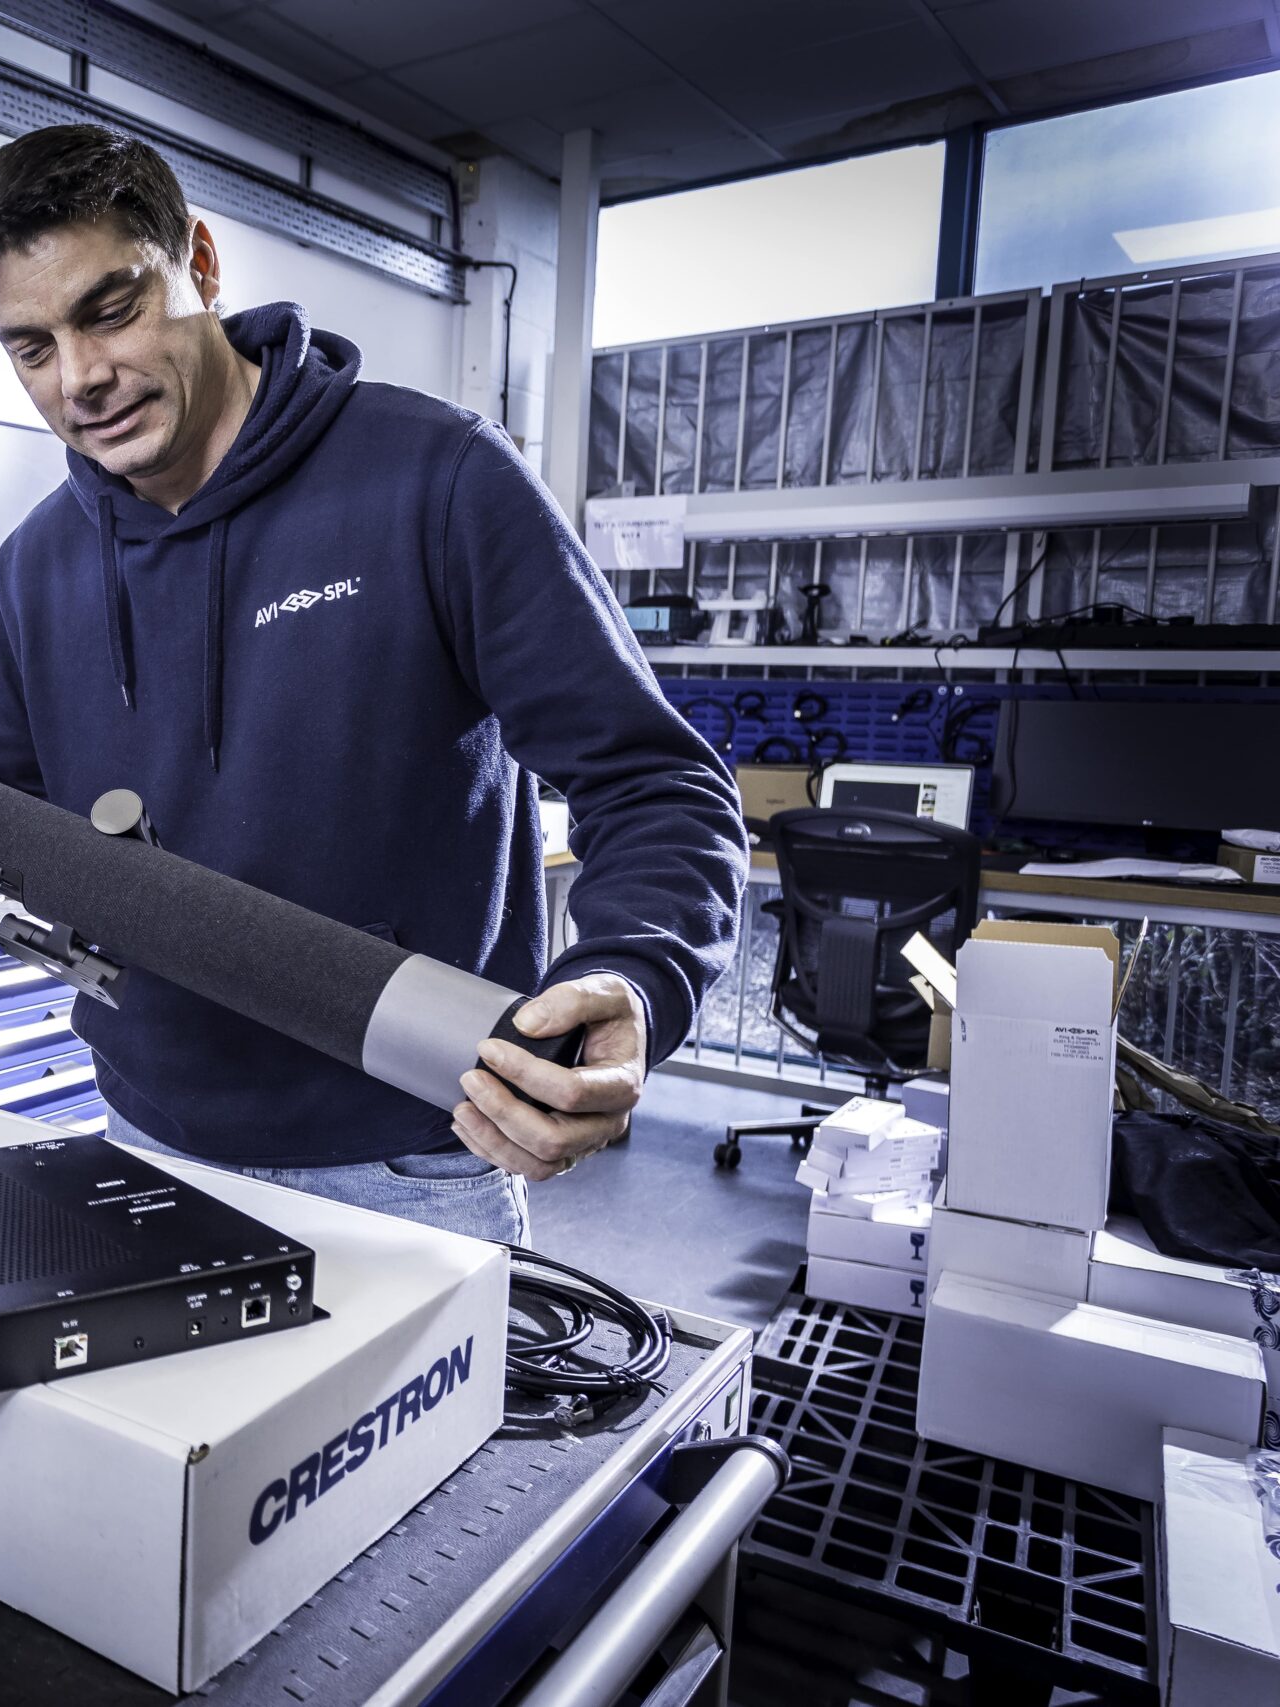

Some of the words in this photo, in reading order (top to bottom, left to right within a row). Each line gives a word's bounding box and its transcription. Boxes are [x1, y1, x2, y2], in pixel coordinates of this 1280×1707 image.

[254, 602, 278, 628] AVI
[128, 1200, 176, 1214] CRESTRON
[249, 1335, 474, 1546] CRESTRON
